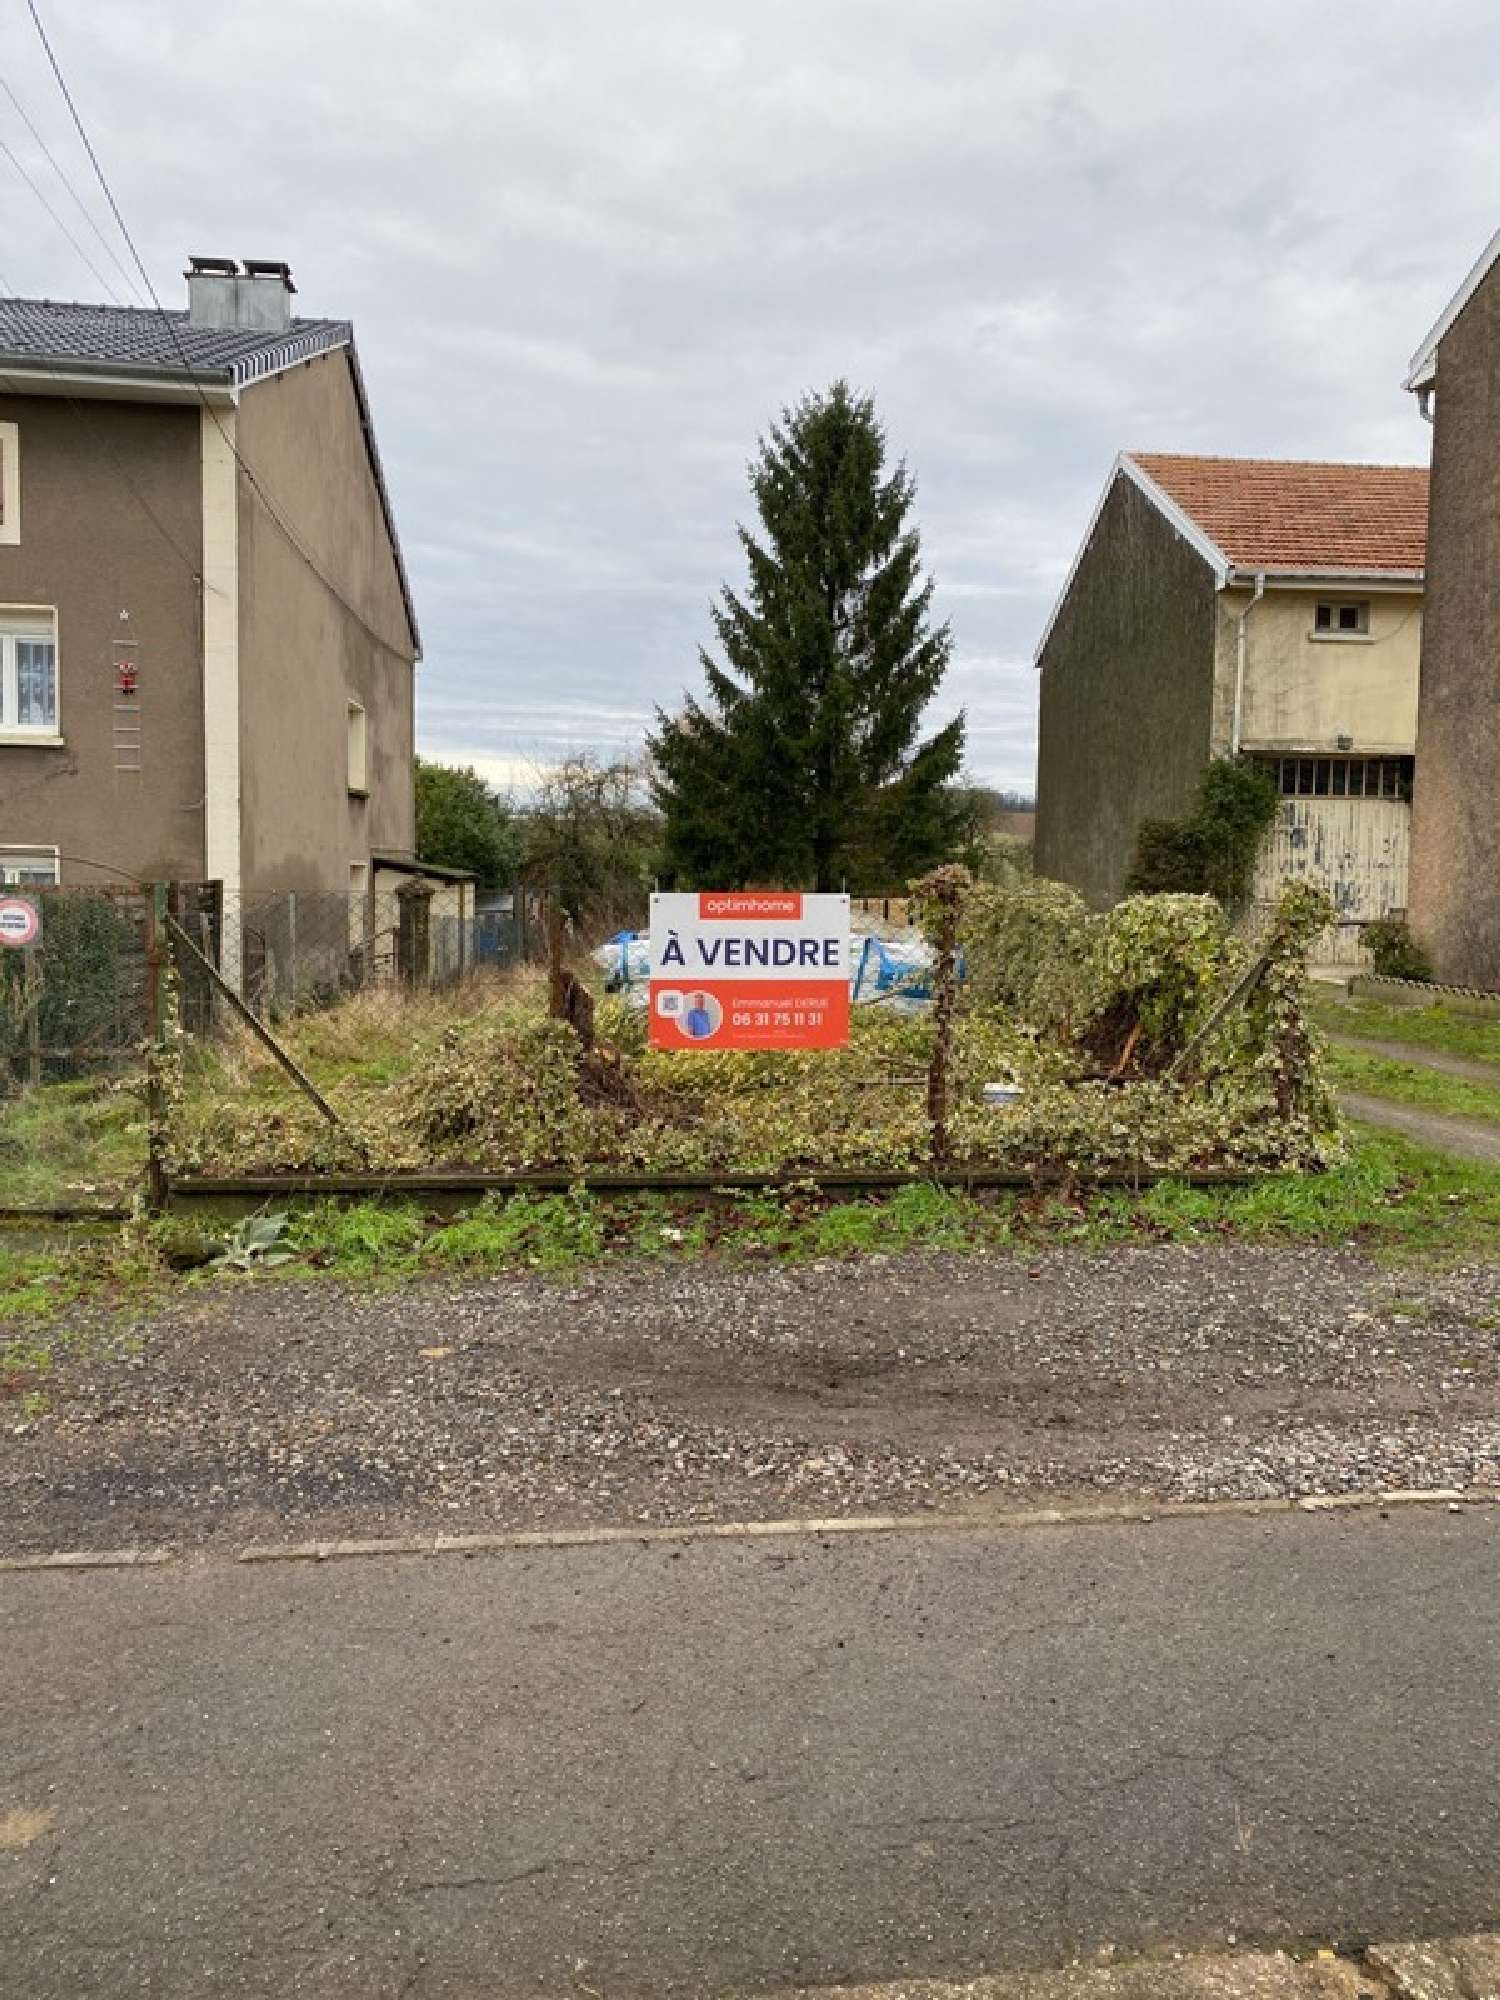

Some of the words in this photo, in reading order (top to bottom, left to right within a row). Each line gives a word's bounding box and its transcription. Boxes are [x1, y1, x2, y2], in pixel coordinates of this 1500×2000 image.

[706, 898, 795, 914] optimhome
[660, 929, 686, 966] À
[697, 938, 841, 966] VENDRE
[732, 998, 793, 1009] Emmanuel
[732, 1012, 751, 1026] 06
[754, 1012, 769, 1026] 31
[772, 1012, 791, 1026] 75
[794, 1012, 806, 1026] 11
[807, 1012, 824, 1026] 31
